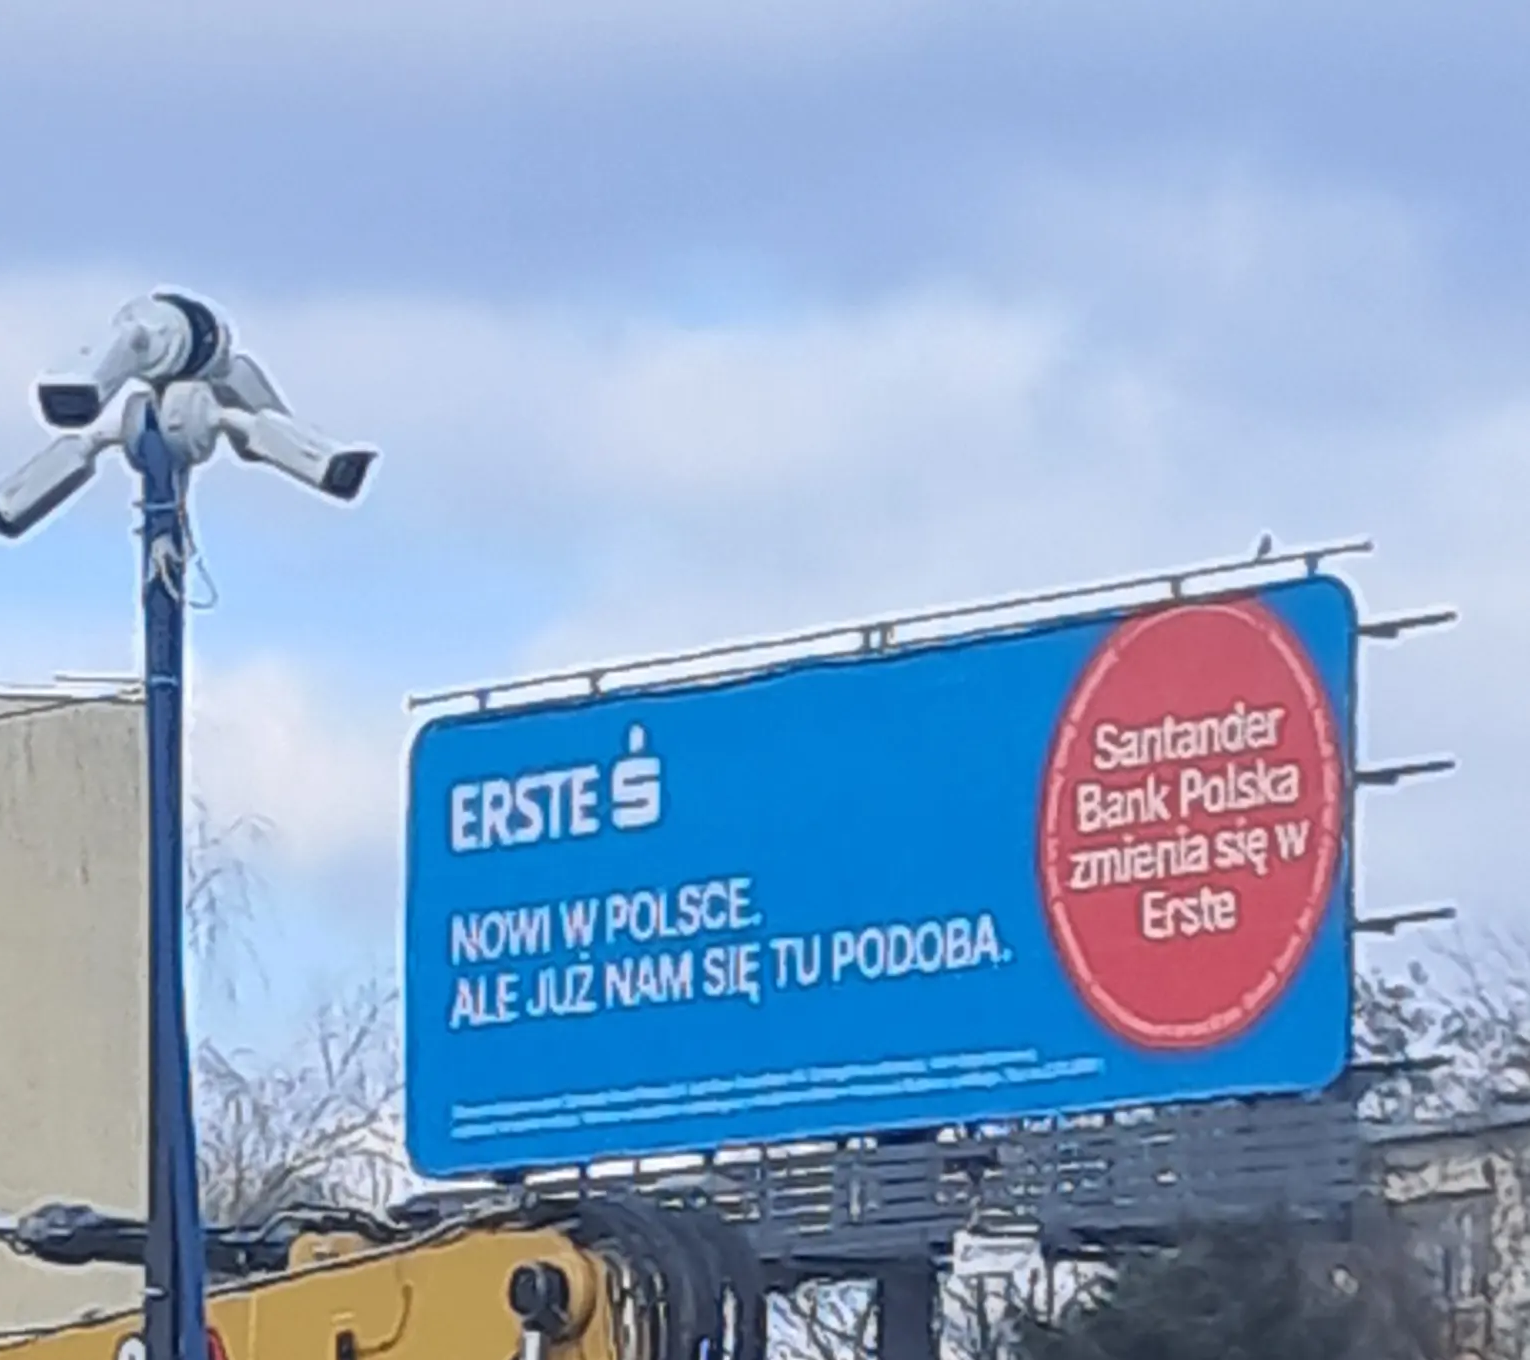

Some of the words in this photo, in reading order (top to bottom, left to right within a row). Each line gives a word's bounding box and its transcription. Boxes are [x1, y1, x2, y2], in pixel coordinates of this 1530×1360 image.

[1094, 701, 1285, 770] Santander
[451, 764, 601, 852] ERSTE
[1077, 772, 1171, 833] Bank
[1180, 758, 1300, 818] Polska
[1067, 824, 1210, 890] zmienia
[1215, 816, 1269, 876] się
[451, 904, 552, 966] NOWI
[559, 897, 600, 950] W
[606, 876, 763, 944] POLSCE.
[1142, 886, 1237, 940] Erste
[448, 972, 521, 1030] ALE
[525, 950, 598, 1017] JUŻ
[604, 950, 695, 1009] NAM
[702, 942, 762, 1005] SIĘ
[769, 933, 821, 989] TU
[831, 912, 1014, 983] PODOBA.
